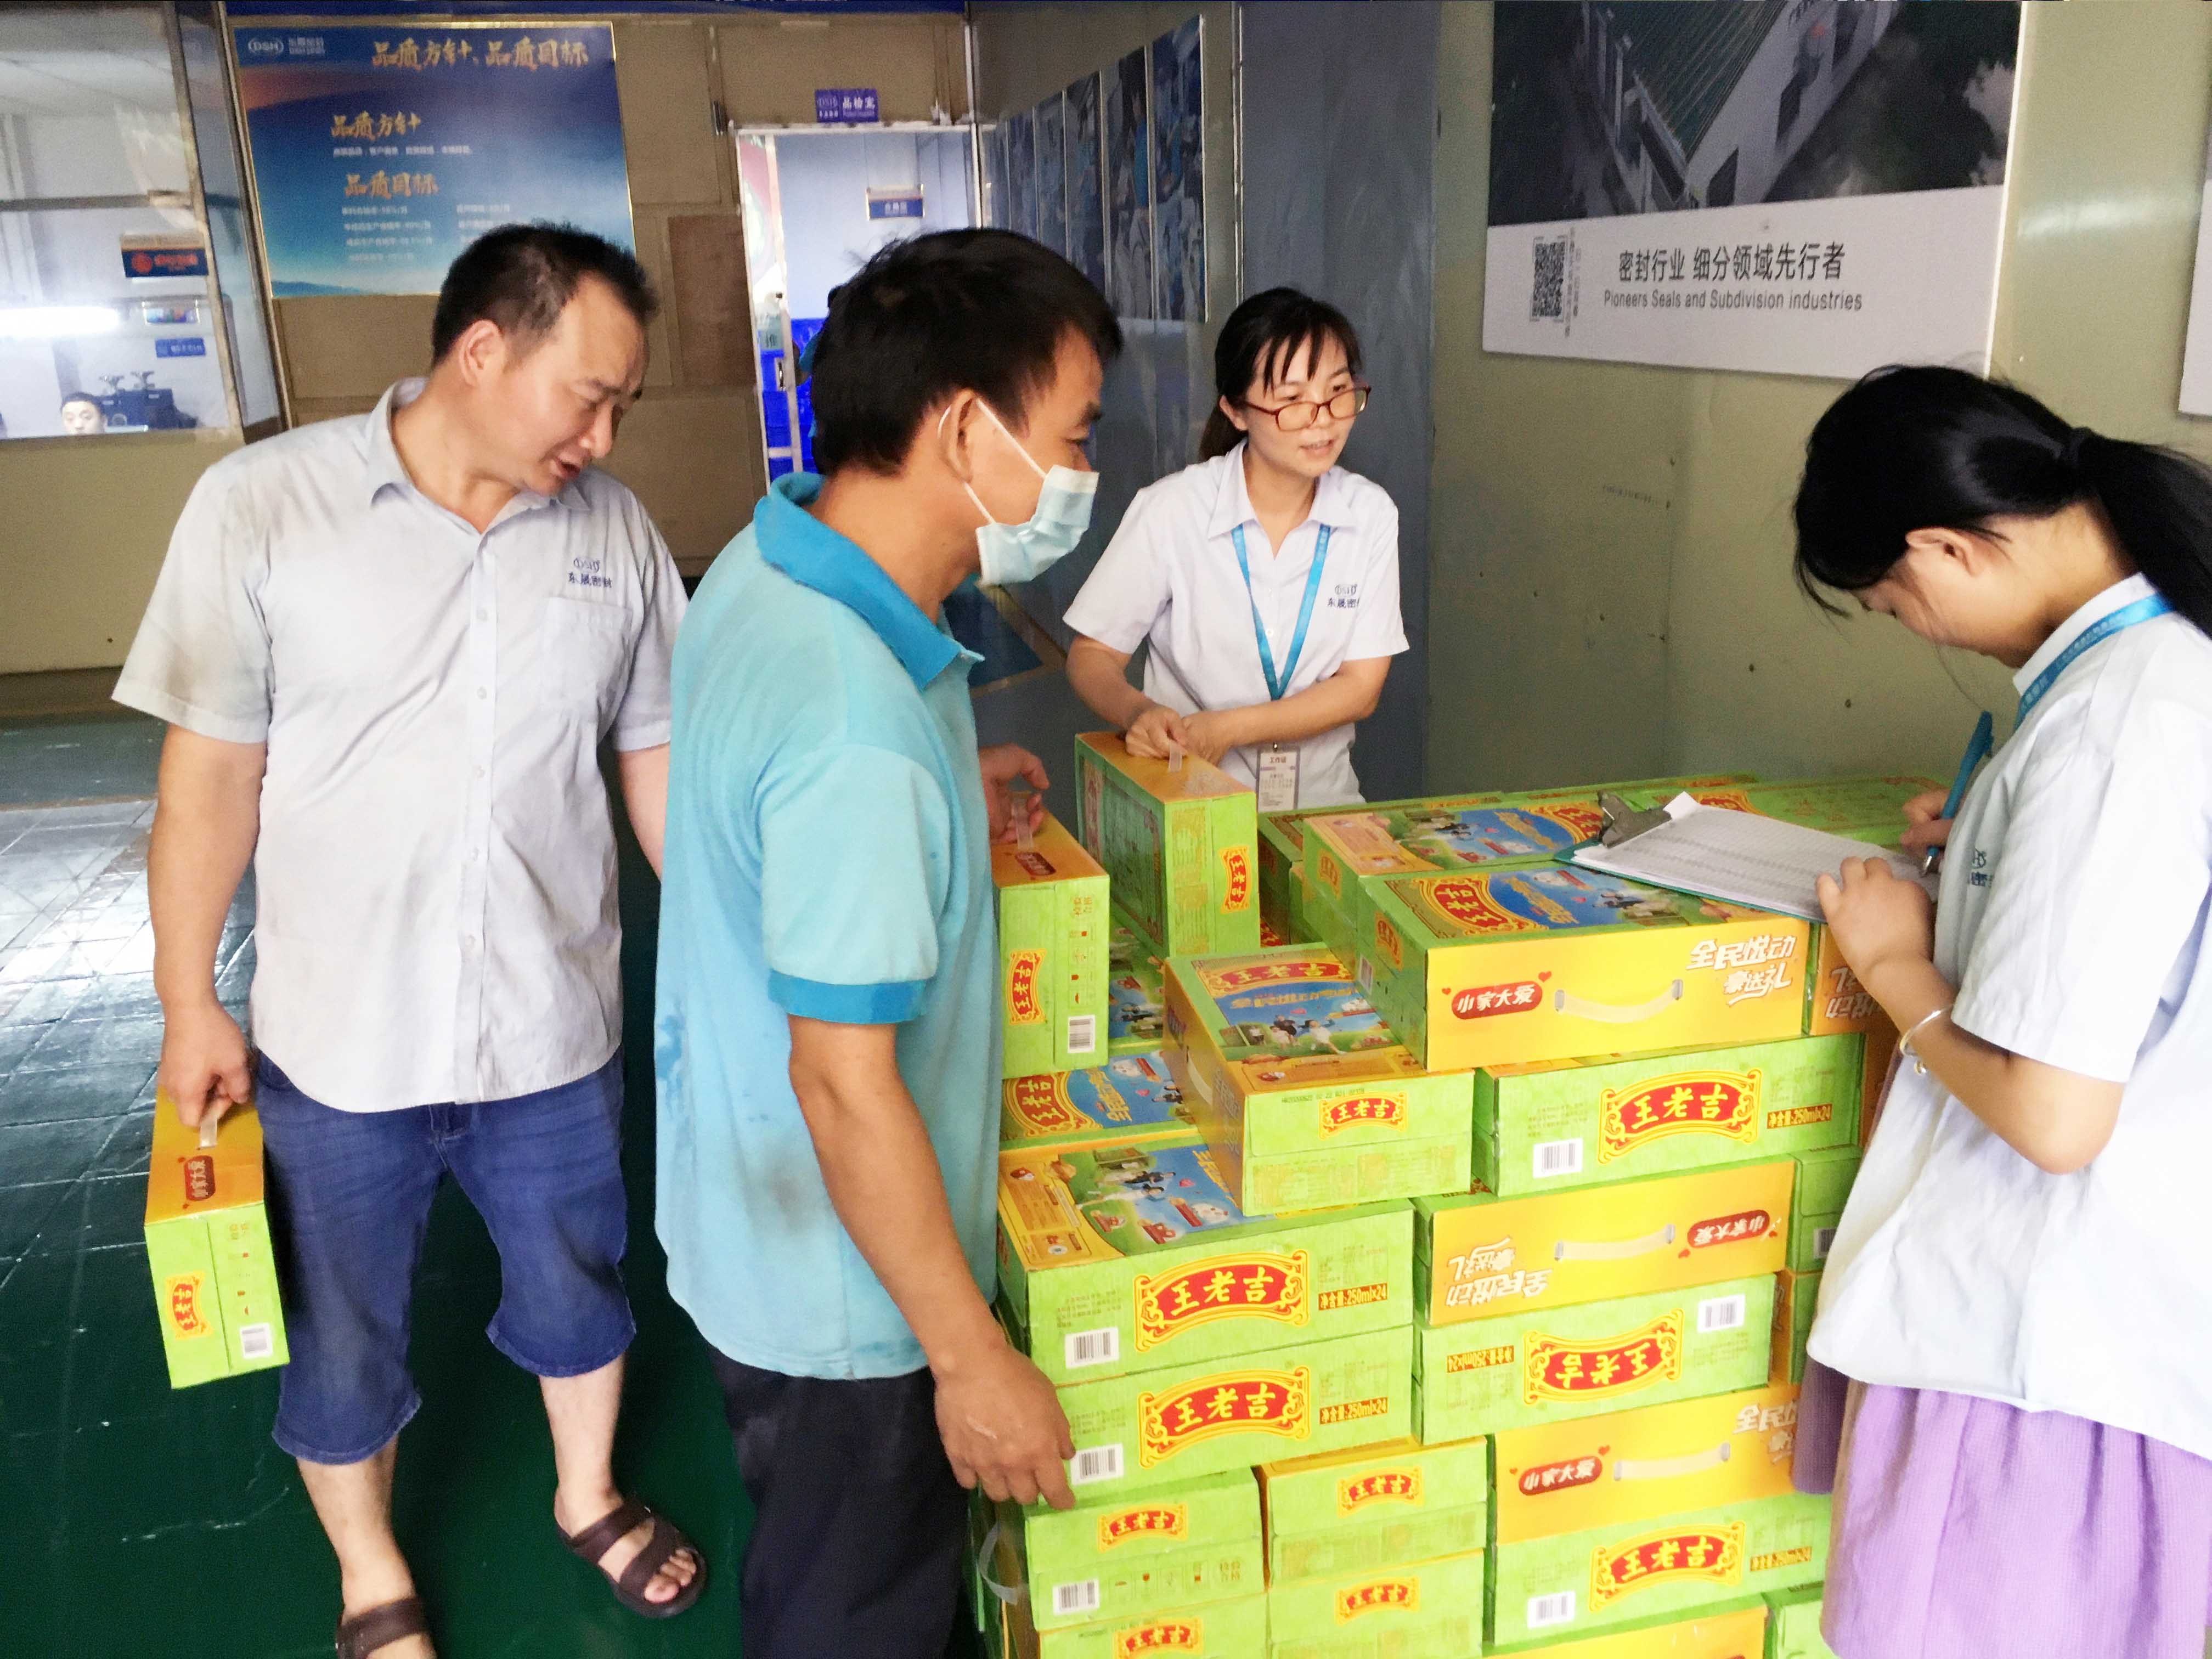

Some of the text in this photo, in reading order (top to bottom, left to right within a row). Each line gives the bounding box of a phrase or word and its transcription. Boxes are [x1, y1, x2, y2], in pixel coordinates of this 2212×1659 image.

[1619, 241, 1844, 281] 密封行业 细分领域先行者
[1604, 289, 1647, 308] Pioneers
[1652, 289, 1681, 308] Seals
[1685, 290, 1706, 308] and
[1710, 289, 1784, 309] Subdivision
[1231, 855, 1246, 903] 王老吉
[1437, 888, 1502, 922] 王老吉
[1686, 934, 1798, 971] 全民悦动
[1014, 966, 1032, 1015] 王老吉
[1237, 962, 1328, 984] 王老吉
[1456, 985, 1537, 1014] 小家大爱
[1018, 1079, 1065, 1121] 王老吉
[1337, 1099, 1390, 1123] 王老吉
[1631, 1084, 1730, 1128] 王老吉
[1171, 1266, 1274, 1317] 王老吉
[1444, 1268, 1552, 1307] 全民悦动
[173, 1288, 198, 1330] 王老吉
[1554, 1341, 1654, 1389] 王老吉
[1175, 1383, 1277, 1432] 王老吉
[1355, 1474, 1404, 1500] 王老吉
[1115, 1510, 1169, 1534] 王老吉
[1621, 1535, 1715, 1581] 王老吉
[1353, 1583, 1403, 1608] 王老吉
[1131, 1624, 1187, 1651] 王老吉
